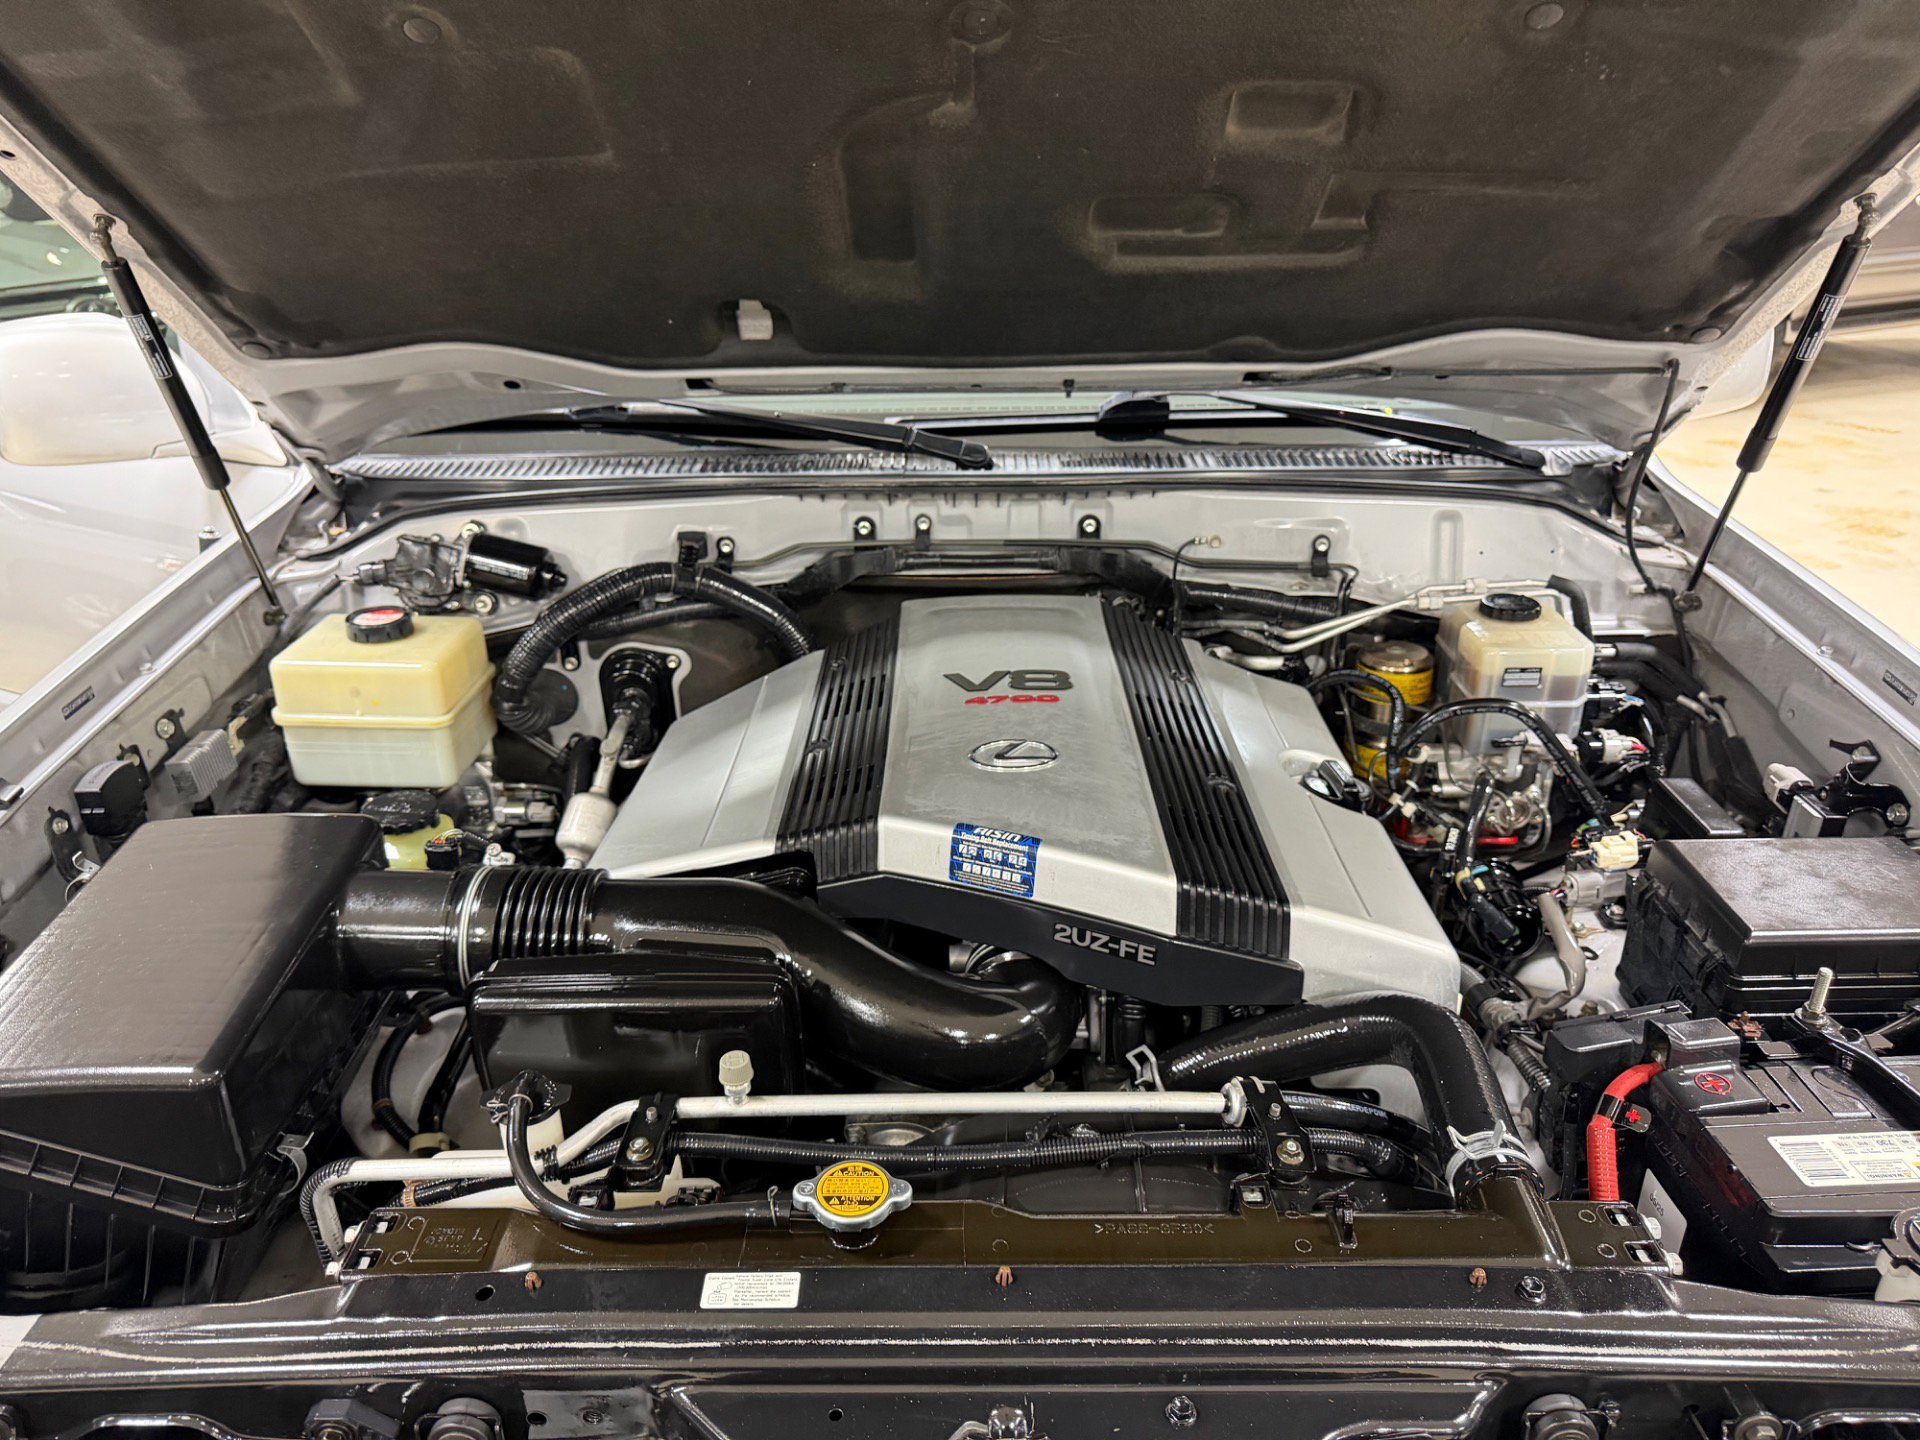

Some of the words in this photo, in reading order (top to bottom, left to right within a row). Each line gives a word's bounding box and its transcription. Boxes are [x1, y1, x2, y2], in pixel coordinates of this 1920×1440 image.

[942, 669, 1074, 692] V8
[964, 694, 1060, 705] 4700
[1053, 923, 1156, 966] 2UZ-FE
